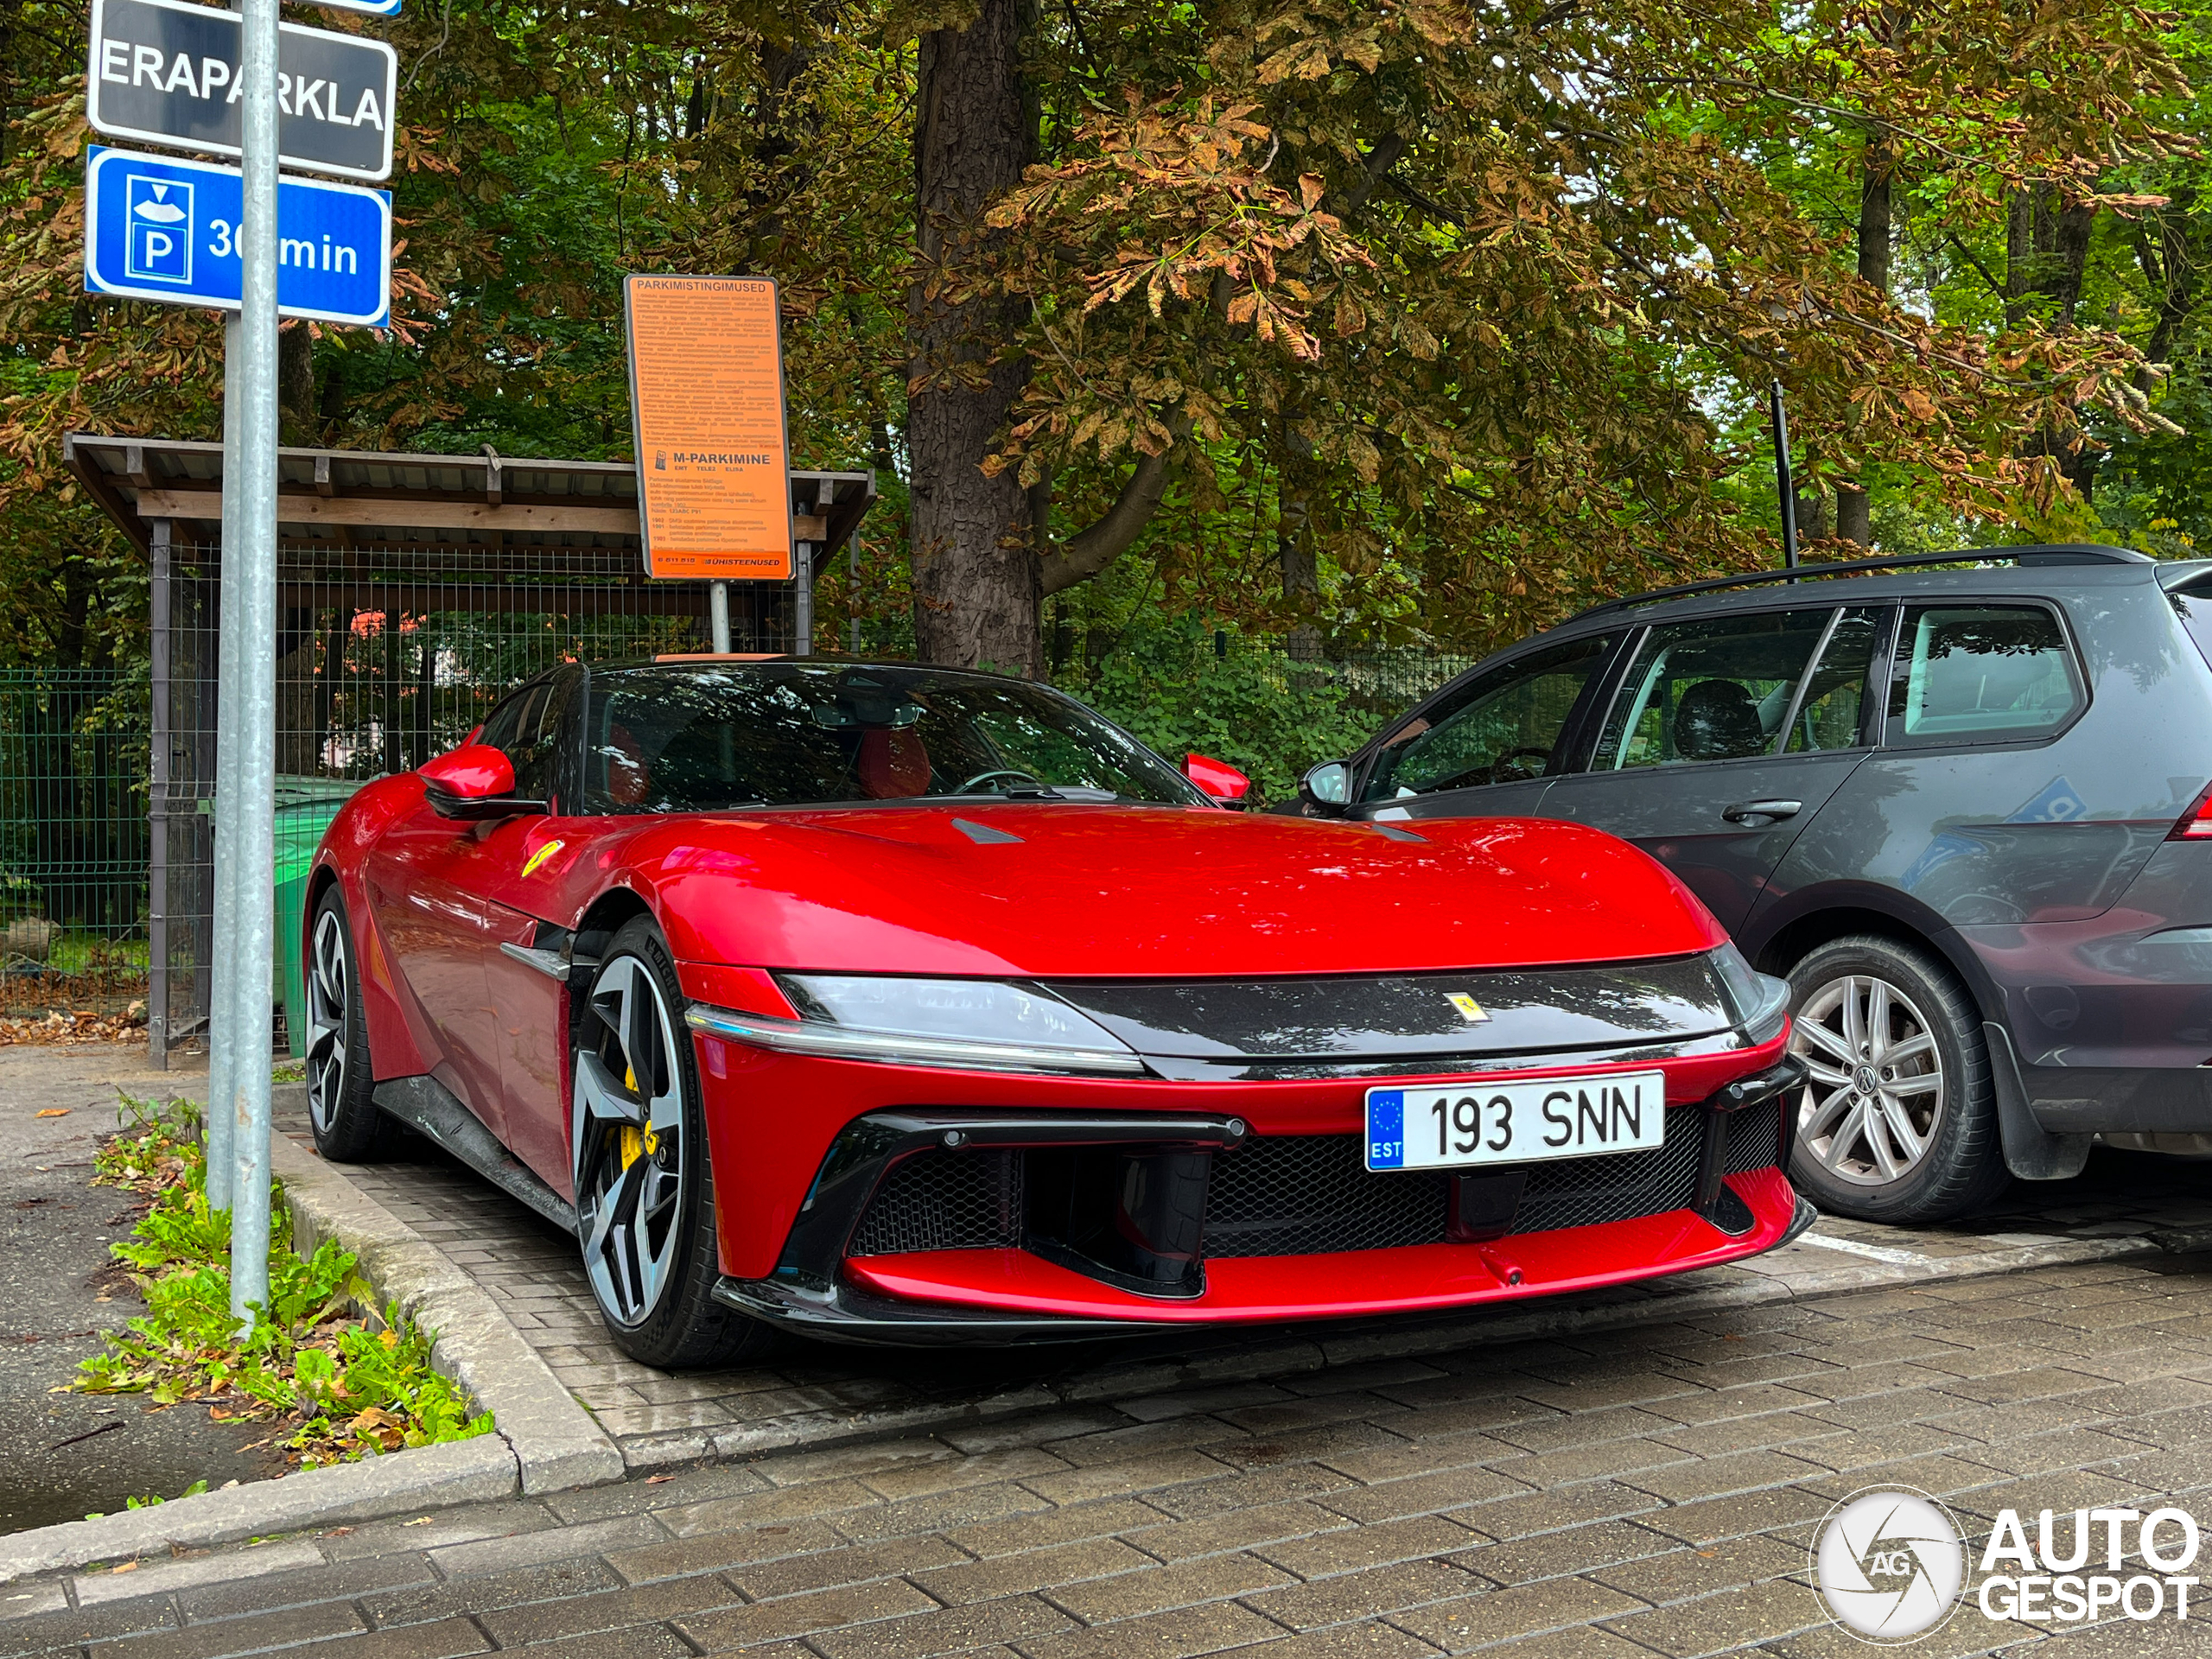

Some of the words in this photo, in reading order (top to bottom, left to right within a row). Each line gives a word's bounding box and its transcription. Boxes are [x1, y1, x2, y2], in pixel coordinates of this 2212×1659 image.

[144, 230, 174, 269] P
[279, 234, 358, 275] min
[637, 280, 766, 293] PARKIMISTINGIMUSED
[673, 453, 771, 465] M-PARKIMINE
[712, 557, 780, 567] ÜHISTEENUSED
[653, 950, 686, 1027] MICHELIN
[683, 1039, 692, 1066] PILOT
[687, 1070, 696, 1105] SPORT
[1431, 1094, 1513, 1155] 193
[1541, 1084, 1641, 1147] SNN
[1371, 1141, 1402, 1158] EST
